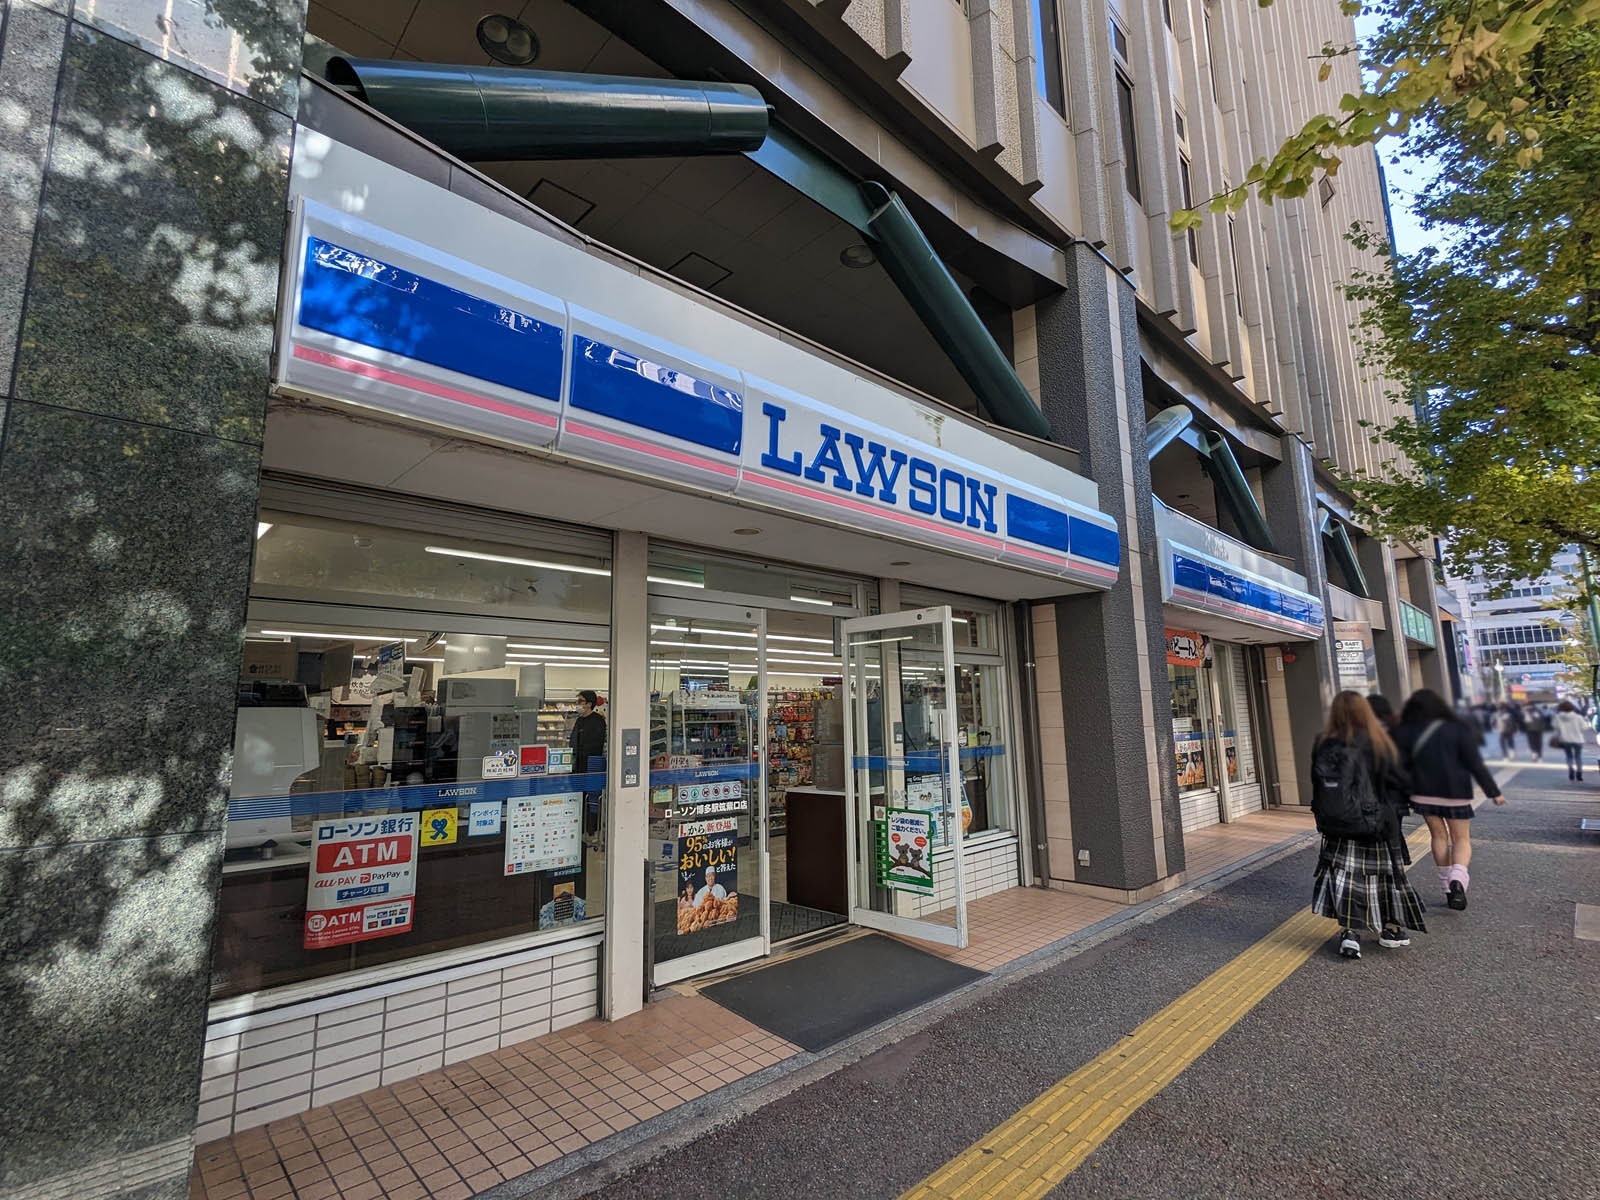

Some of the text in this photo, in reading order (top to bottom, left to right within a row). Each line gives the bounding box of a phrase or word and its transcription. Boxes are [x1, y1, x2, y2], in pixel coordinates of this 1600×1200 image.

[762, 402, 997, 534] LAWSON
[438, 787, 477, 797] LAWSON
[318, 817, 413, 841] ローソン銀行
[332, 840, 398, 868] ATM
[338, 876, 357, 886] PAY
[372, 870, 401, 881] PayPay
[328, 911, 361, 928] ATM
